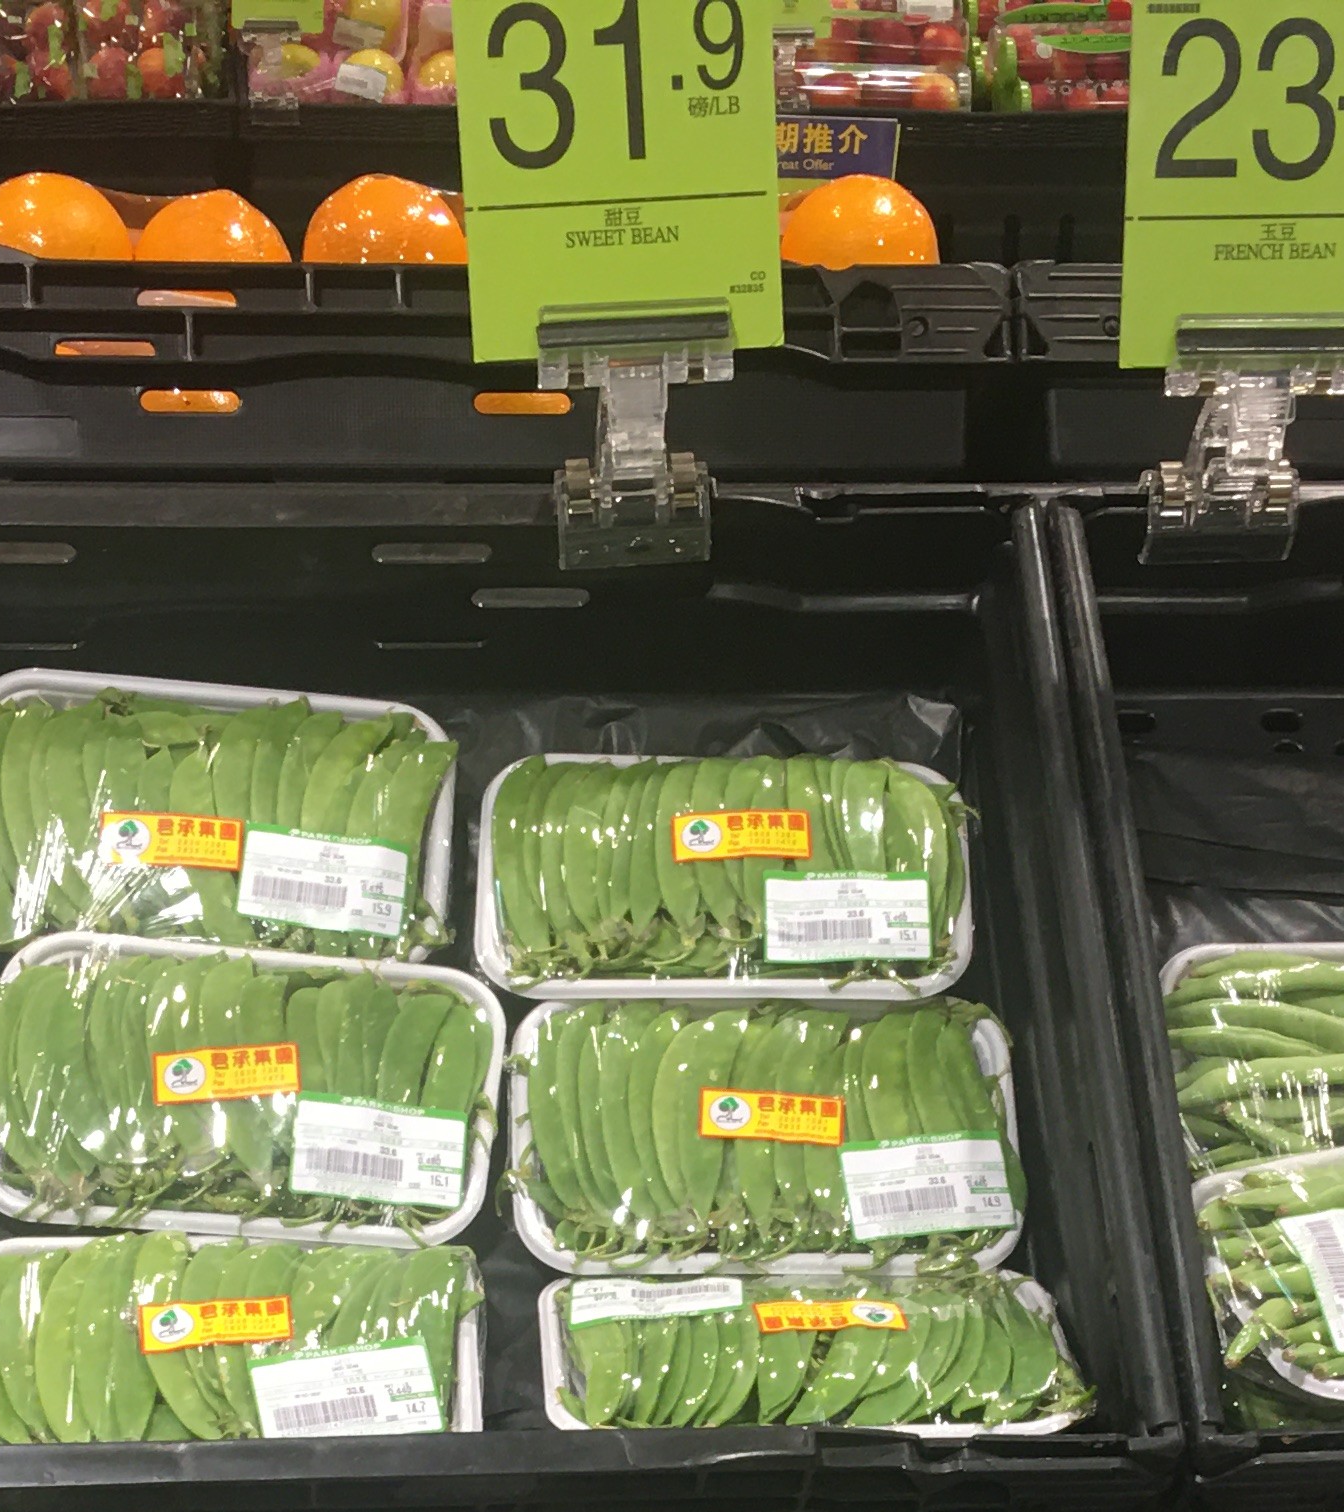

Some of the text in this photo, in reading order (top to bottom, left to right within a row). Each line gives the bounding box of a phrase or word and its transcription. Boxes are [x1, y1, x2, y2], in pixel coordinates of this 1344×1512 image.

[487, 0, 745, 170] 31.9
[605, 206, 642, 227] 甜豆
[565, 225, 680, 249] SWEET BEAN
[1260, 222, 1298, 242] 玉豆
[1213, 242, 1337, 261] FRENCH BEAN
